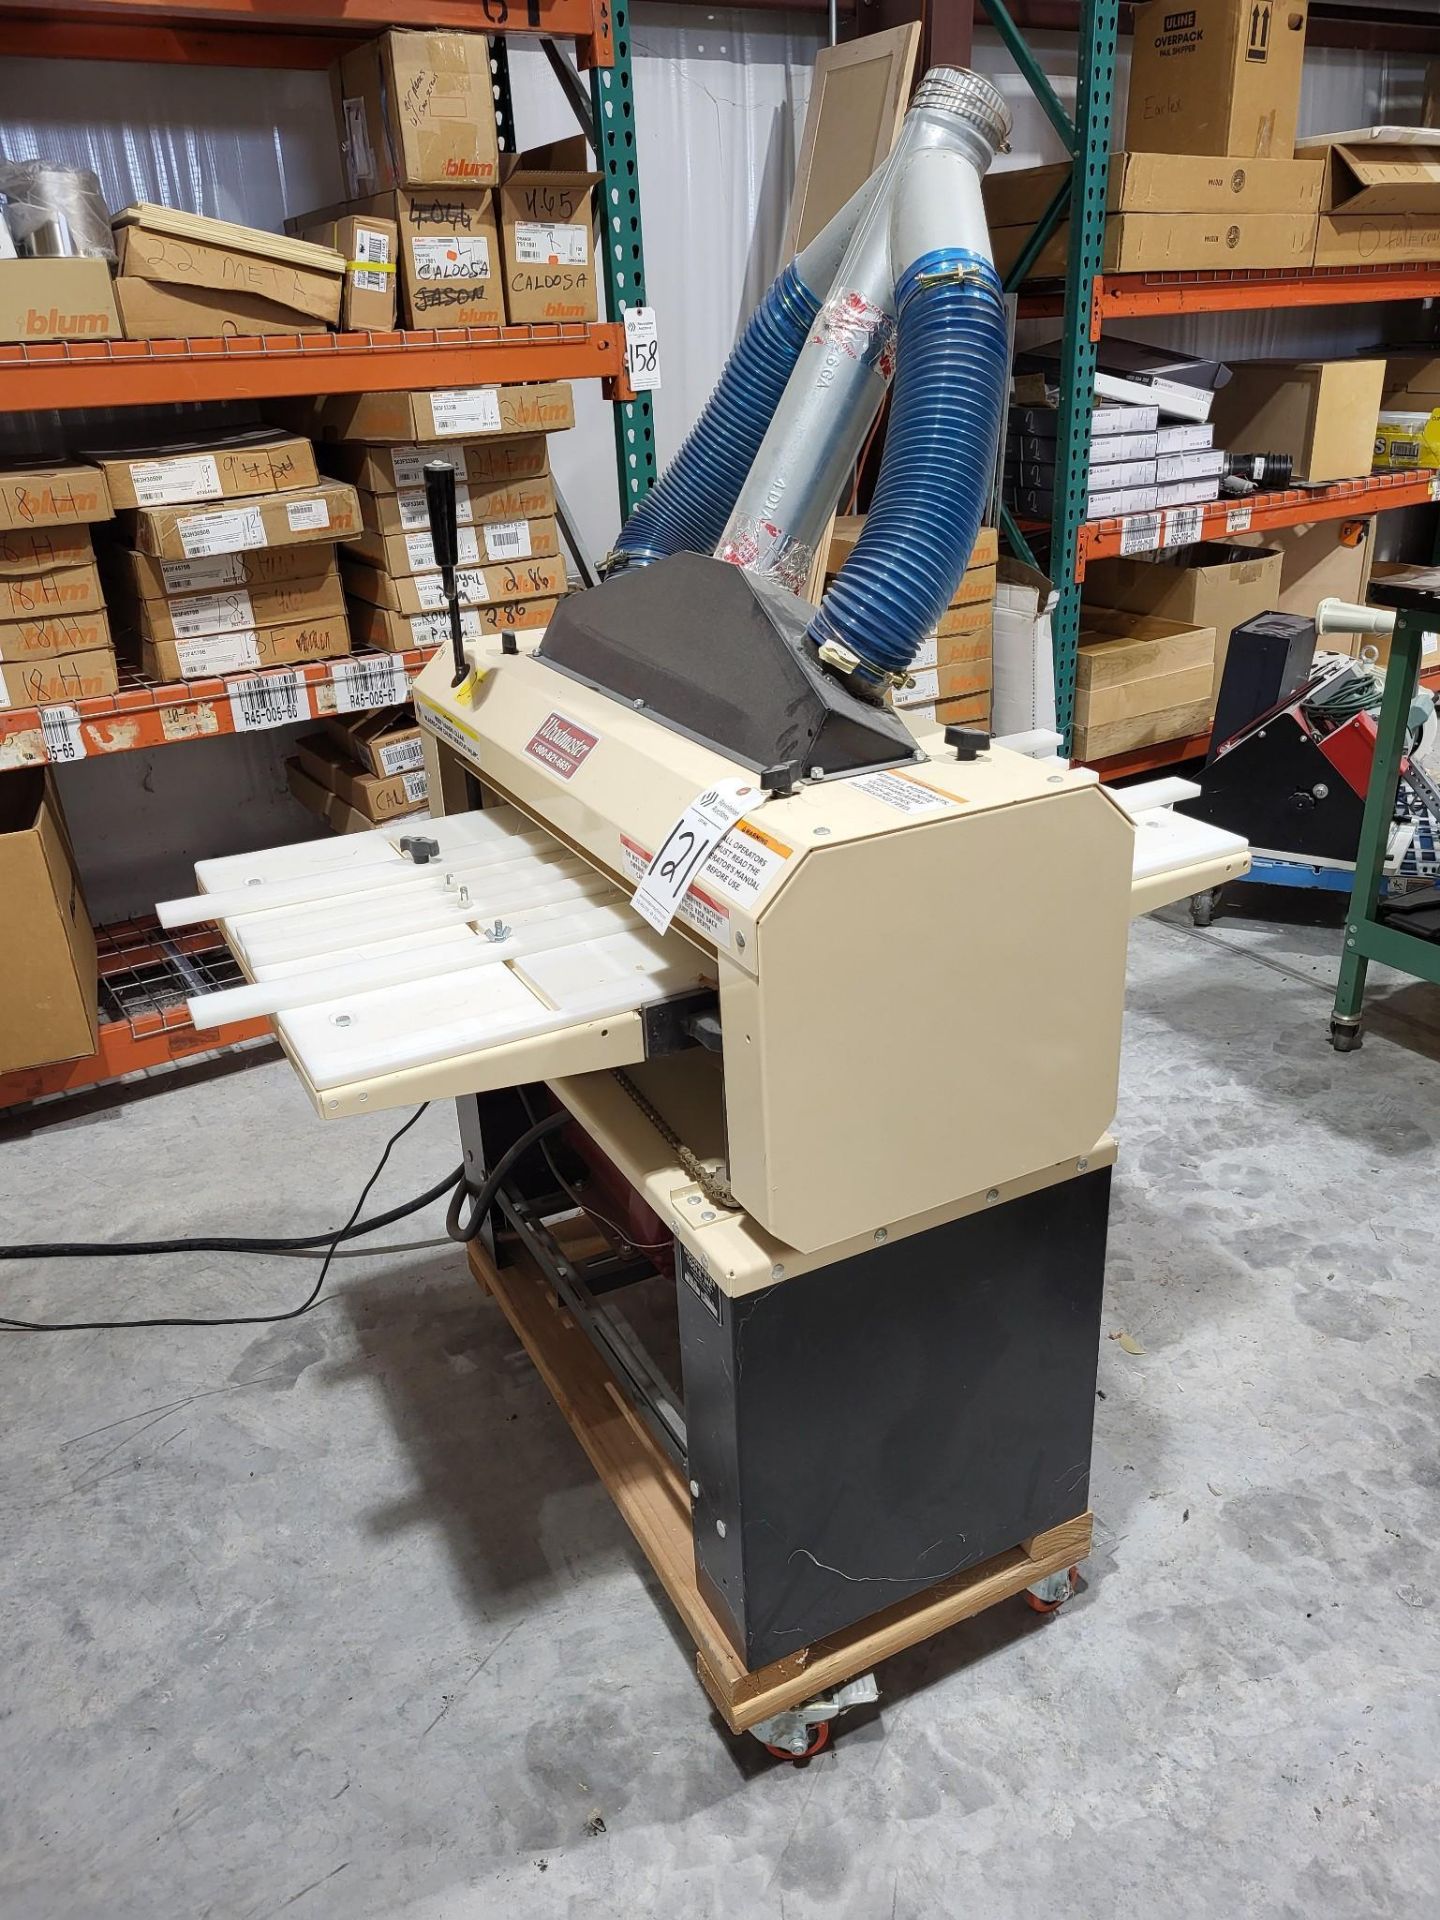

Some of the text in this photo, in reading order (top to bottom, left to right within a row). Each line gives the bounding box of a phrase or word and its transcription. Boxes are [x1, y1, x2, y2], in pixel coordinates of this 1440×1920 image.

[1165, 12, 1195, 29] ULINE
[1154, 30, 1204, 48] OVERPACK
[445, 157, 494, 177] blum
[417, 261, 490, 281] CALOOSA
[511, 272, 589, 292] CALOOSA
[26, 308, 110, 336] blum
[458, 307, 499, 323] blum
[544, 302, 587, 318] blum
[629, 339, 658, 374] 158
[1, 480, 80, 525] 18 H
[21, 487, 98, 518] blum
[7, 572, 63, 615] 18 H
[485, 602, 526, 628] 2.86
[952, 613, 989, 629] blum
[15, 616, 85, 650] 18 H
[952, 645, 989, 660] blum
[21, 661, 85, 702] 18 H
[350, 688, 397, 708] R45-005-67
[244, 704, 298, 726] R45-005-66
[540, 716, 591, 758] Woodmaster
[648, 818, 710, 899] 121
[731, 853, 748, 869] READ
[747, 863, 761, 877] THE
[733, 842, 769, 868] OPERATORS
[706, 863, 729, 883] BEFORE
[708, 852, 761, 892] ERATOR'S MANUAL
